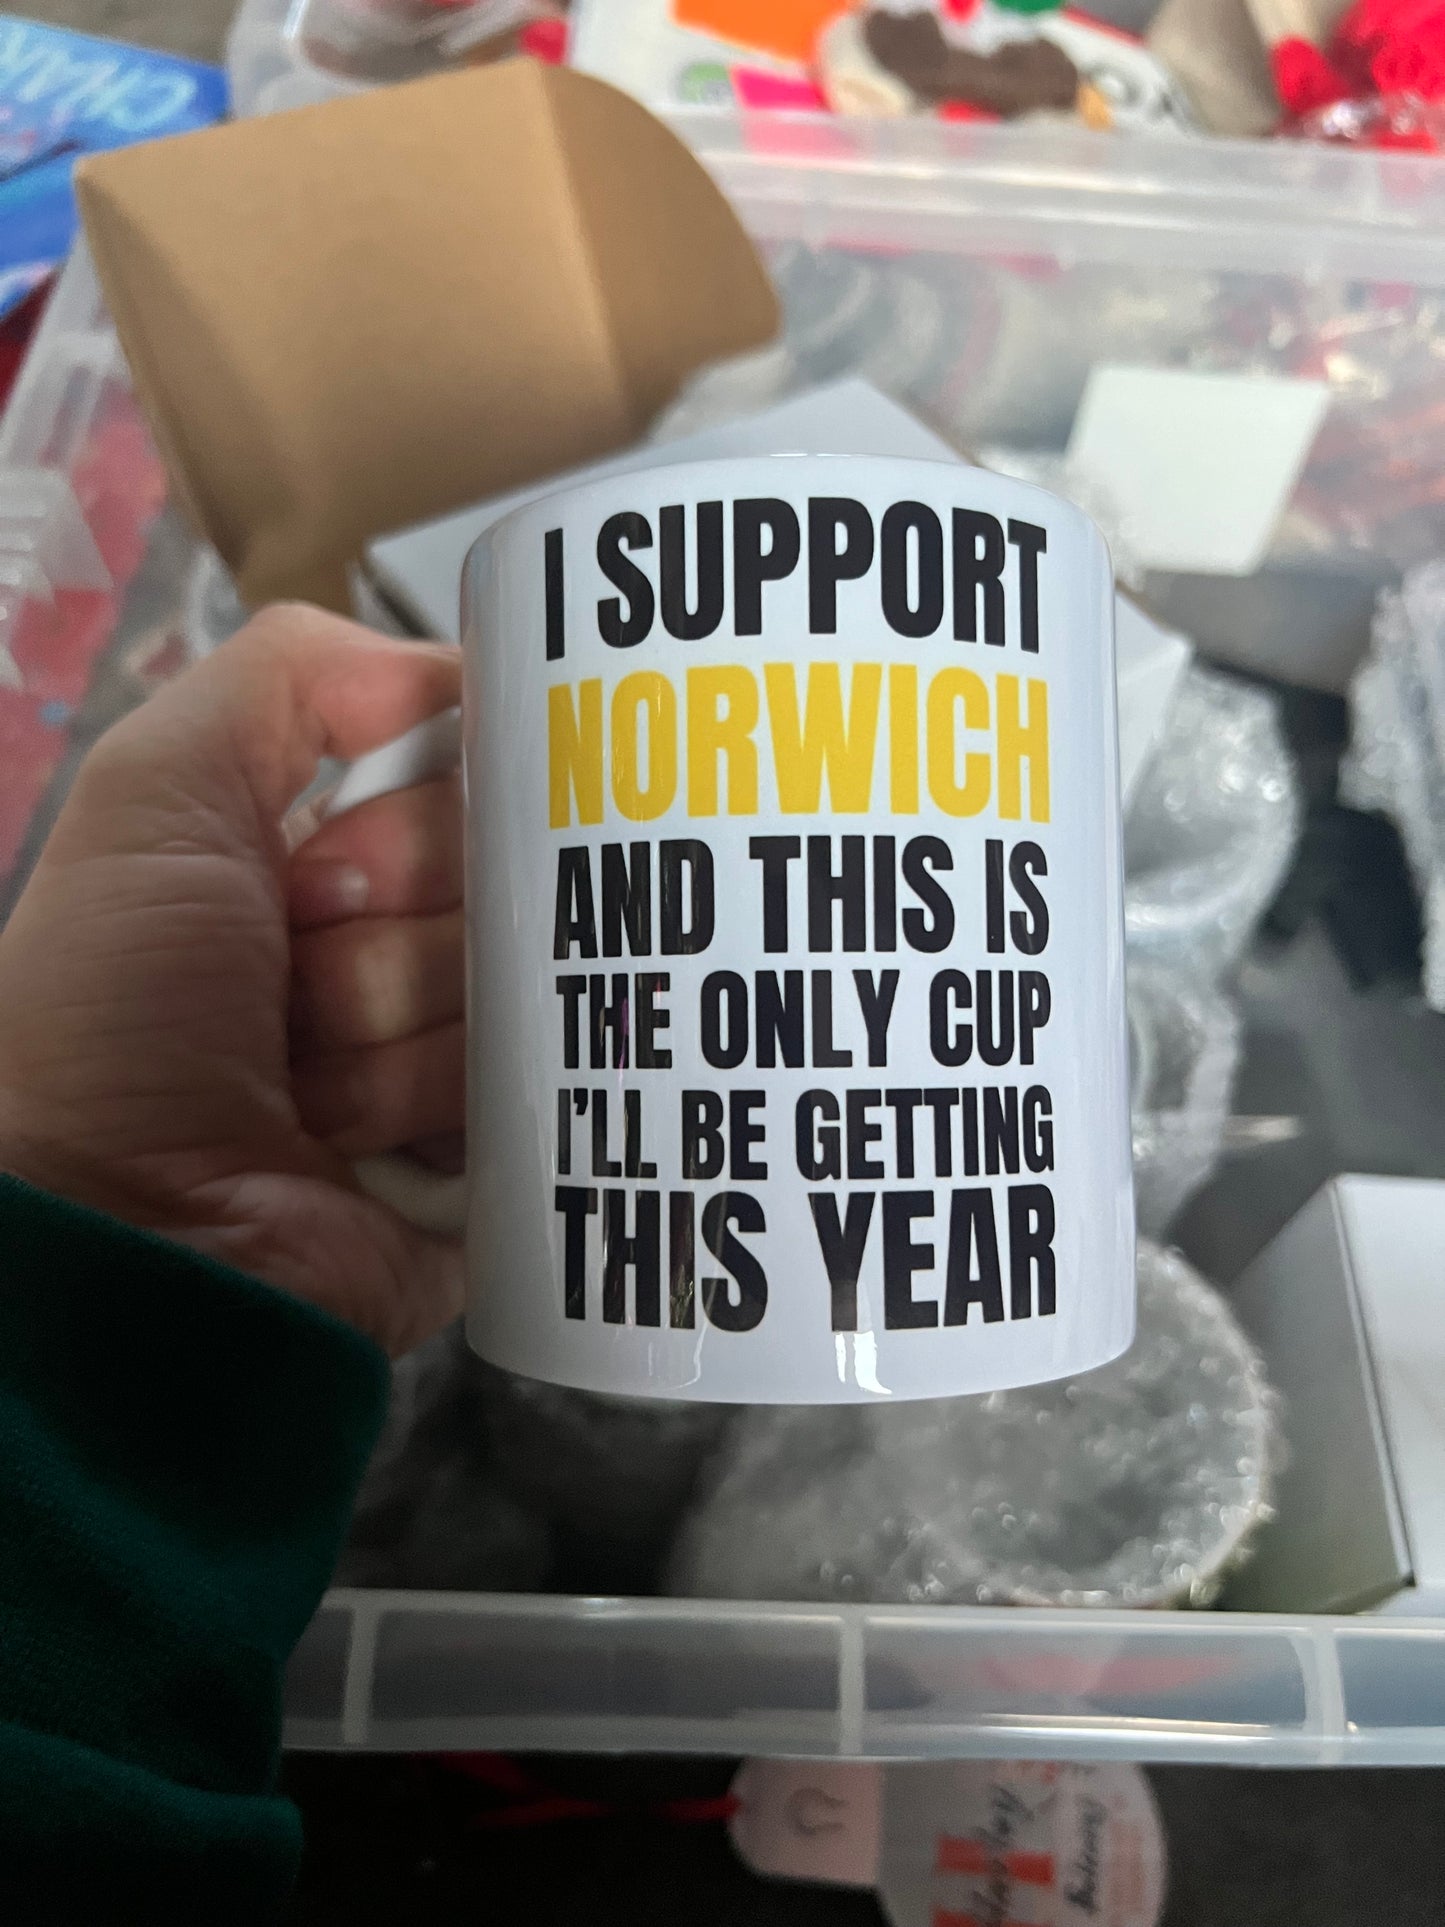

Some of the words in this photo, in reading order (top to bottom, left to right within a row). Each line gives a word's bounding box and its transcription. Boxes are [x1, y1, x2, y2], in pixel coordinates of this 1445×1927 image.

[544, 527, 565, 662] I
[597, 497, 1047, 654] SUPPORT
[548, 663, 1049, 829] NORWICH
[553, 839, 714, 960] AND
[749, 835, 954, 953] THIS
[986, 839, 1049, 955] IS
[556, 972, 672, 1069] THE
[701, 970, 899, 1069] ONLY
[930, 969, 1051, 1067] CUP
[558, 1088, 657, 1179] I'LL
[682, 1090, 767, 1180] BE
[796, 1085, 1054, 1181] GETTING
[554, 1186, 768, 1332] THIS
[808, 1184, 1056, 1331] YEAR
